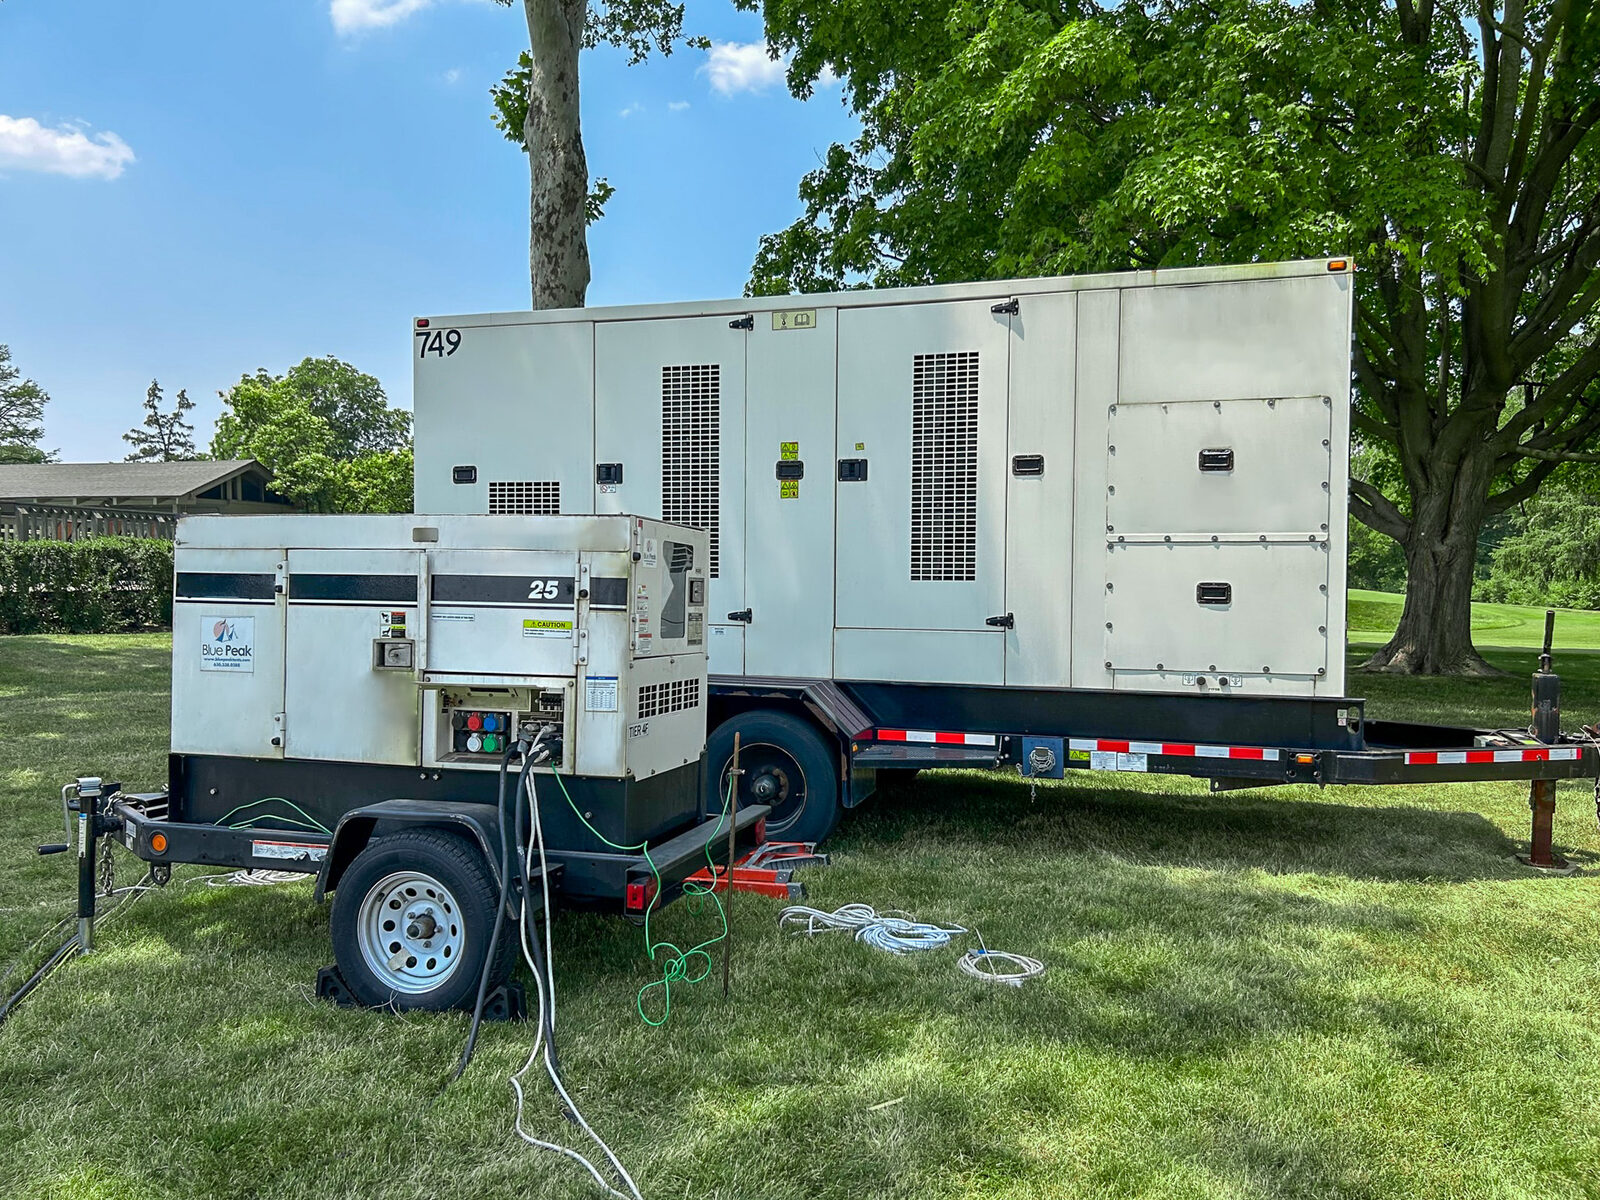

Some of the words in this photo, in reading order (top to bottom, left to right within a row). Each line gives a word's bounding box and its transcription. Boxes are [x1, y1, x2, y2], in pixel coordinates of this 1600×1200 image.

[416, 329, 462, 358] 749
[527, 580, 559, 600] 25
[202, 644, 223, 656] Blue
[225, 644, 252, 657] Peak
[629, 724, 642, 738] TIER
